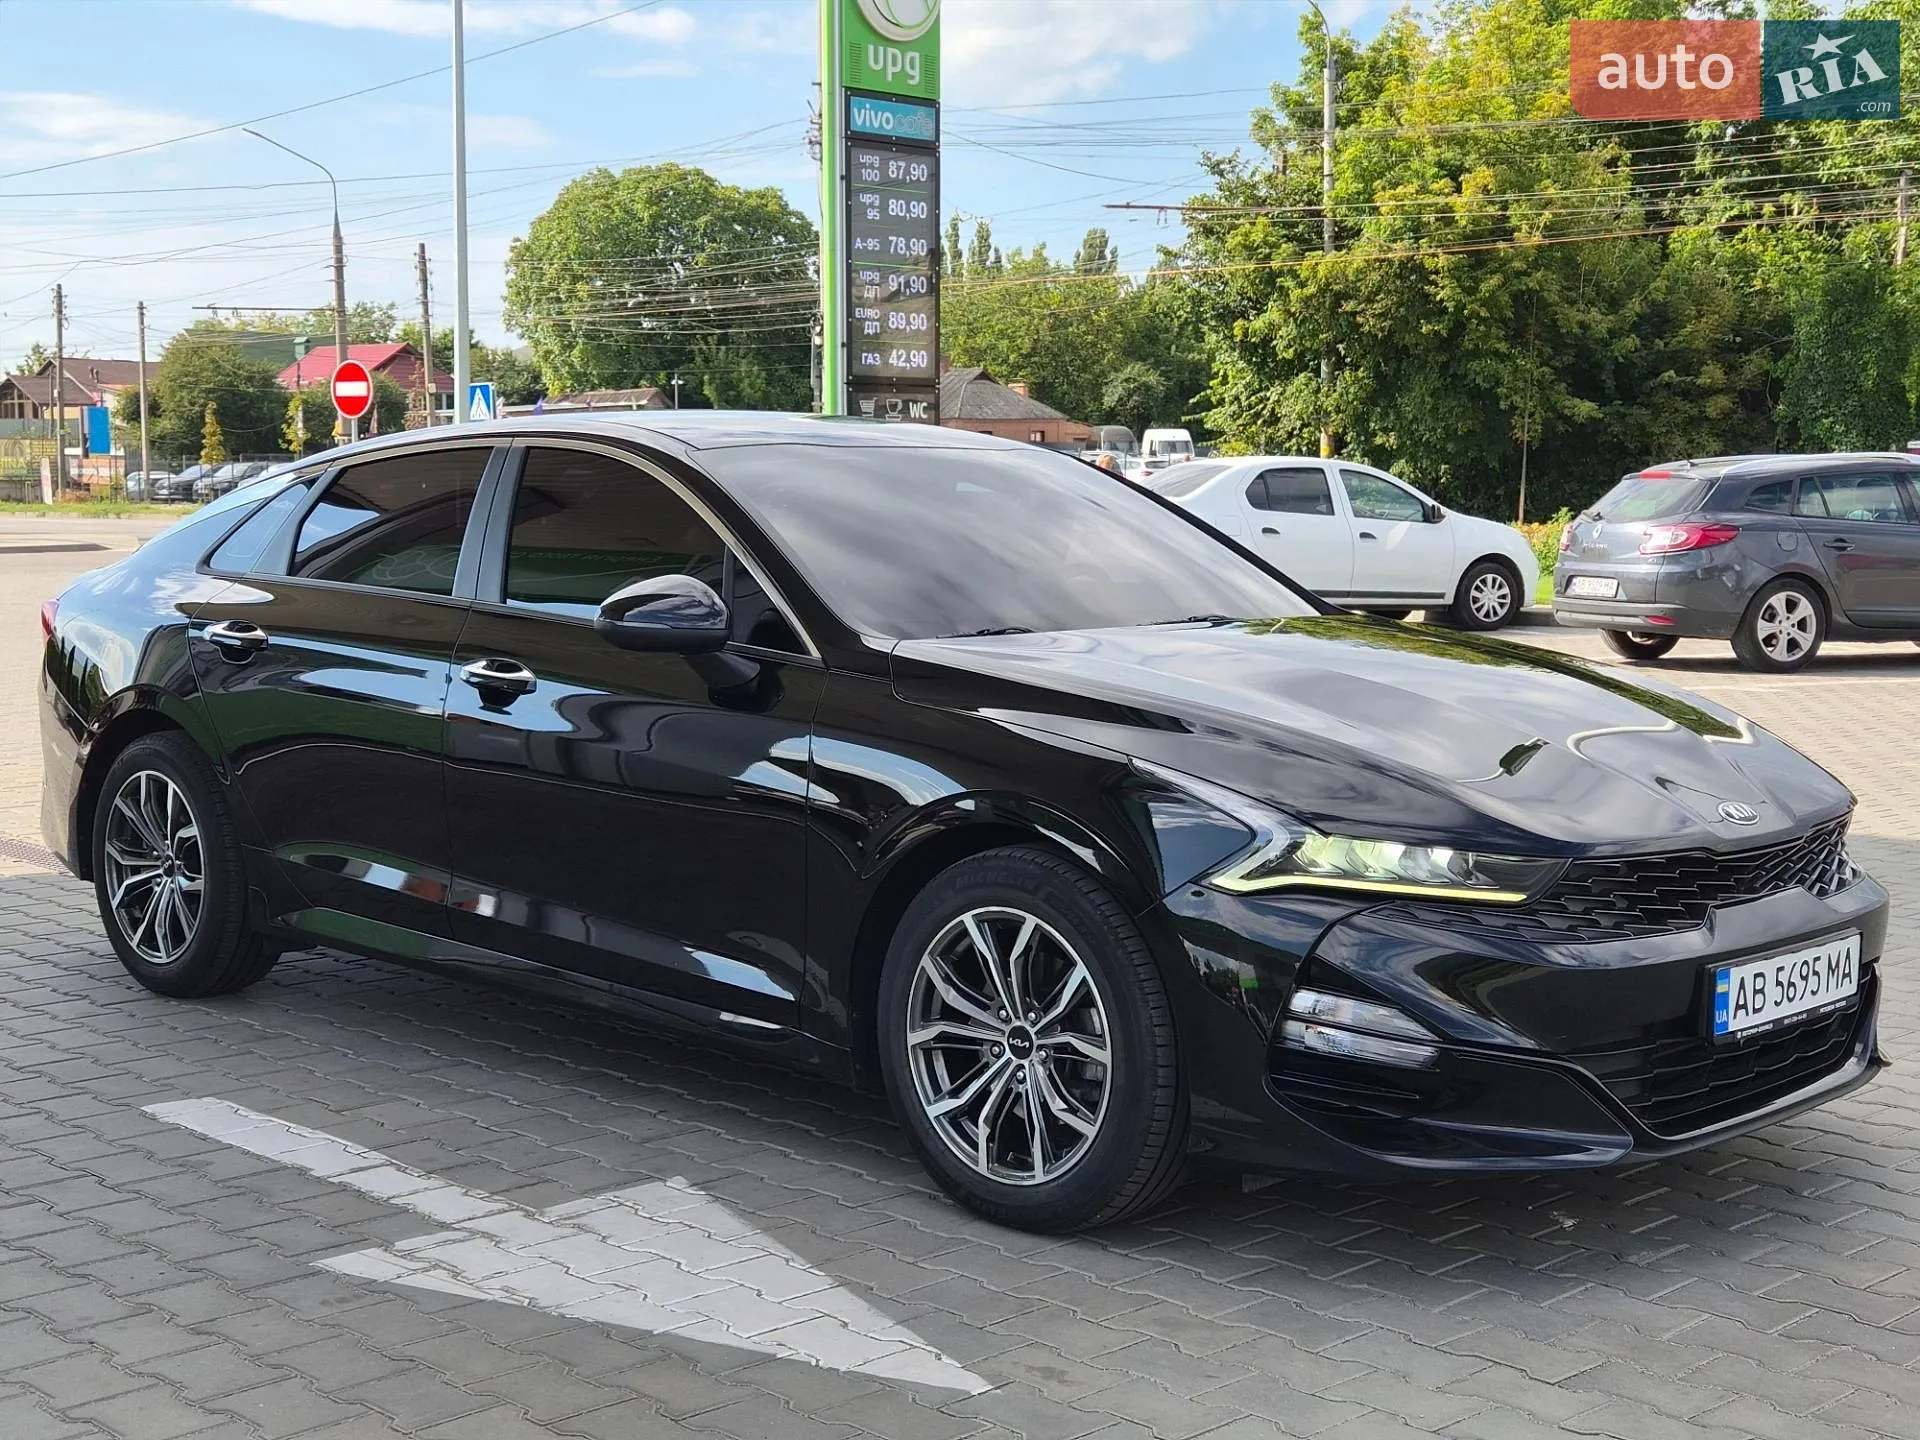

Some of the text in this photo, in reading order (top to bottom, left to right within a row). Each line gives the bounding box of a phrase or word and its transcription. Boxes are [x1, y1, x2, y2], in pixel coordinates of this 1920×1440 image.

[867, 44, 920, 85] upg
[859, 154, 880, 168] upg
[861, 168, 880, 182] 100
[888, 161, 928, 183] 87,90
[859, 193, 880, 207] upg
[867, 208, 880, 220] 95
[888, 199, 928, 221] 80,90
[888, 236, 928, 257] 78,90
[859, 271, 880, 283] upg
[888, 274, 928, 296] 91,90
[855, 307, 881, 319] EURO
[864, 321, 880, 335] ДП
[888, 311, 928, 333] 89,90
[861, 349, 928, 370] ГАЗ 42,90
[909, 402, 928, 418] WC
[1733, 947, 1853, 1020] AB 5695 MA
[1715, 1010, 1728, 1024] UA
